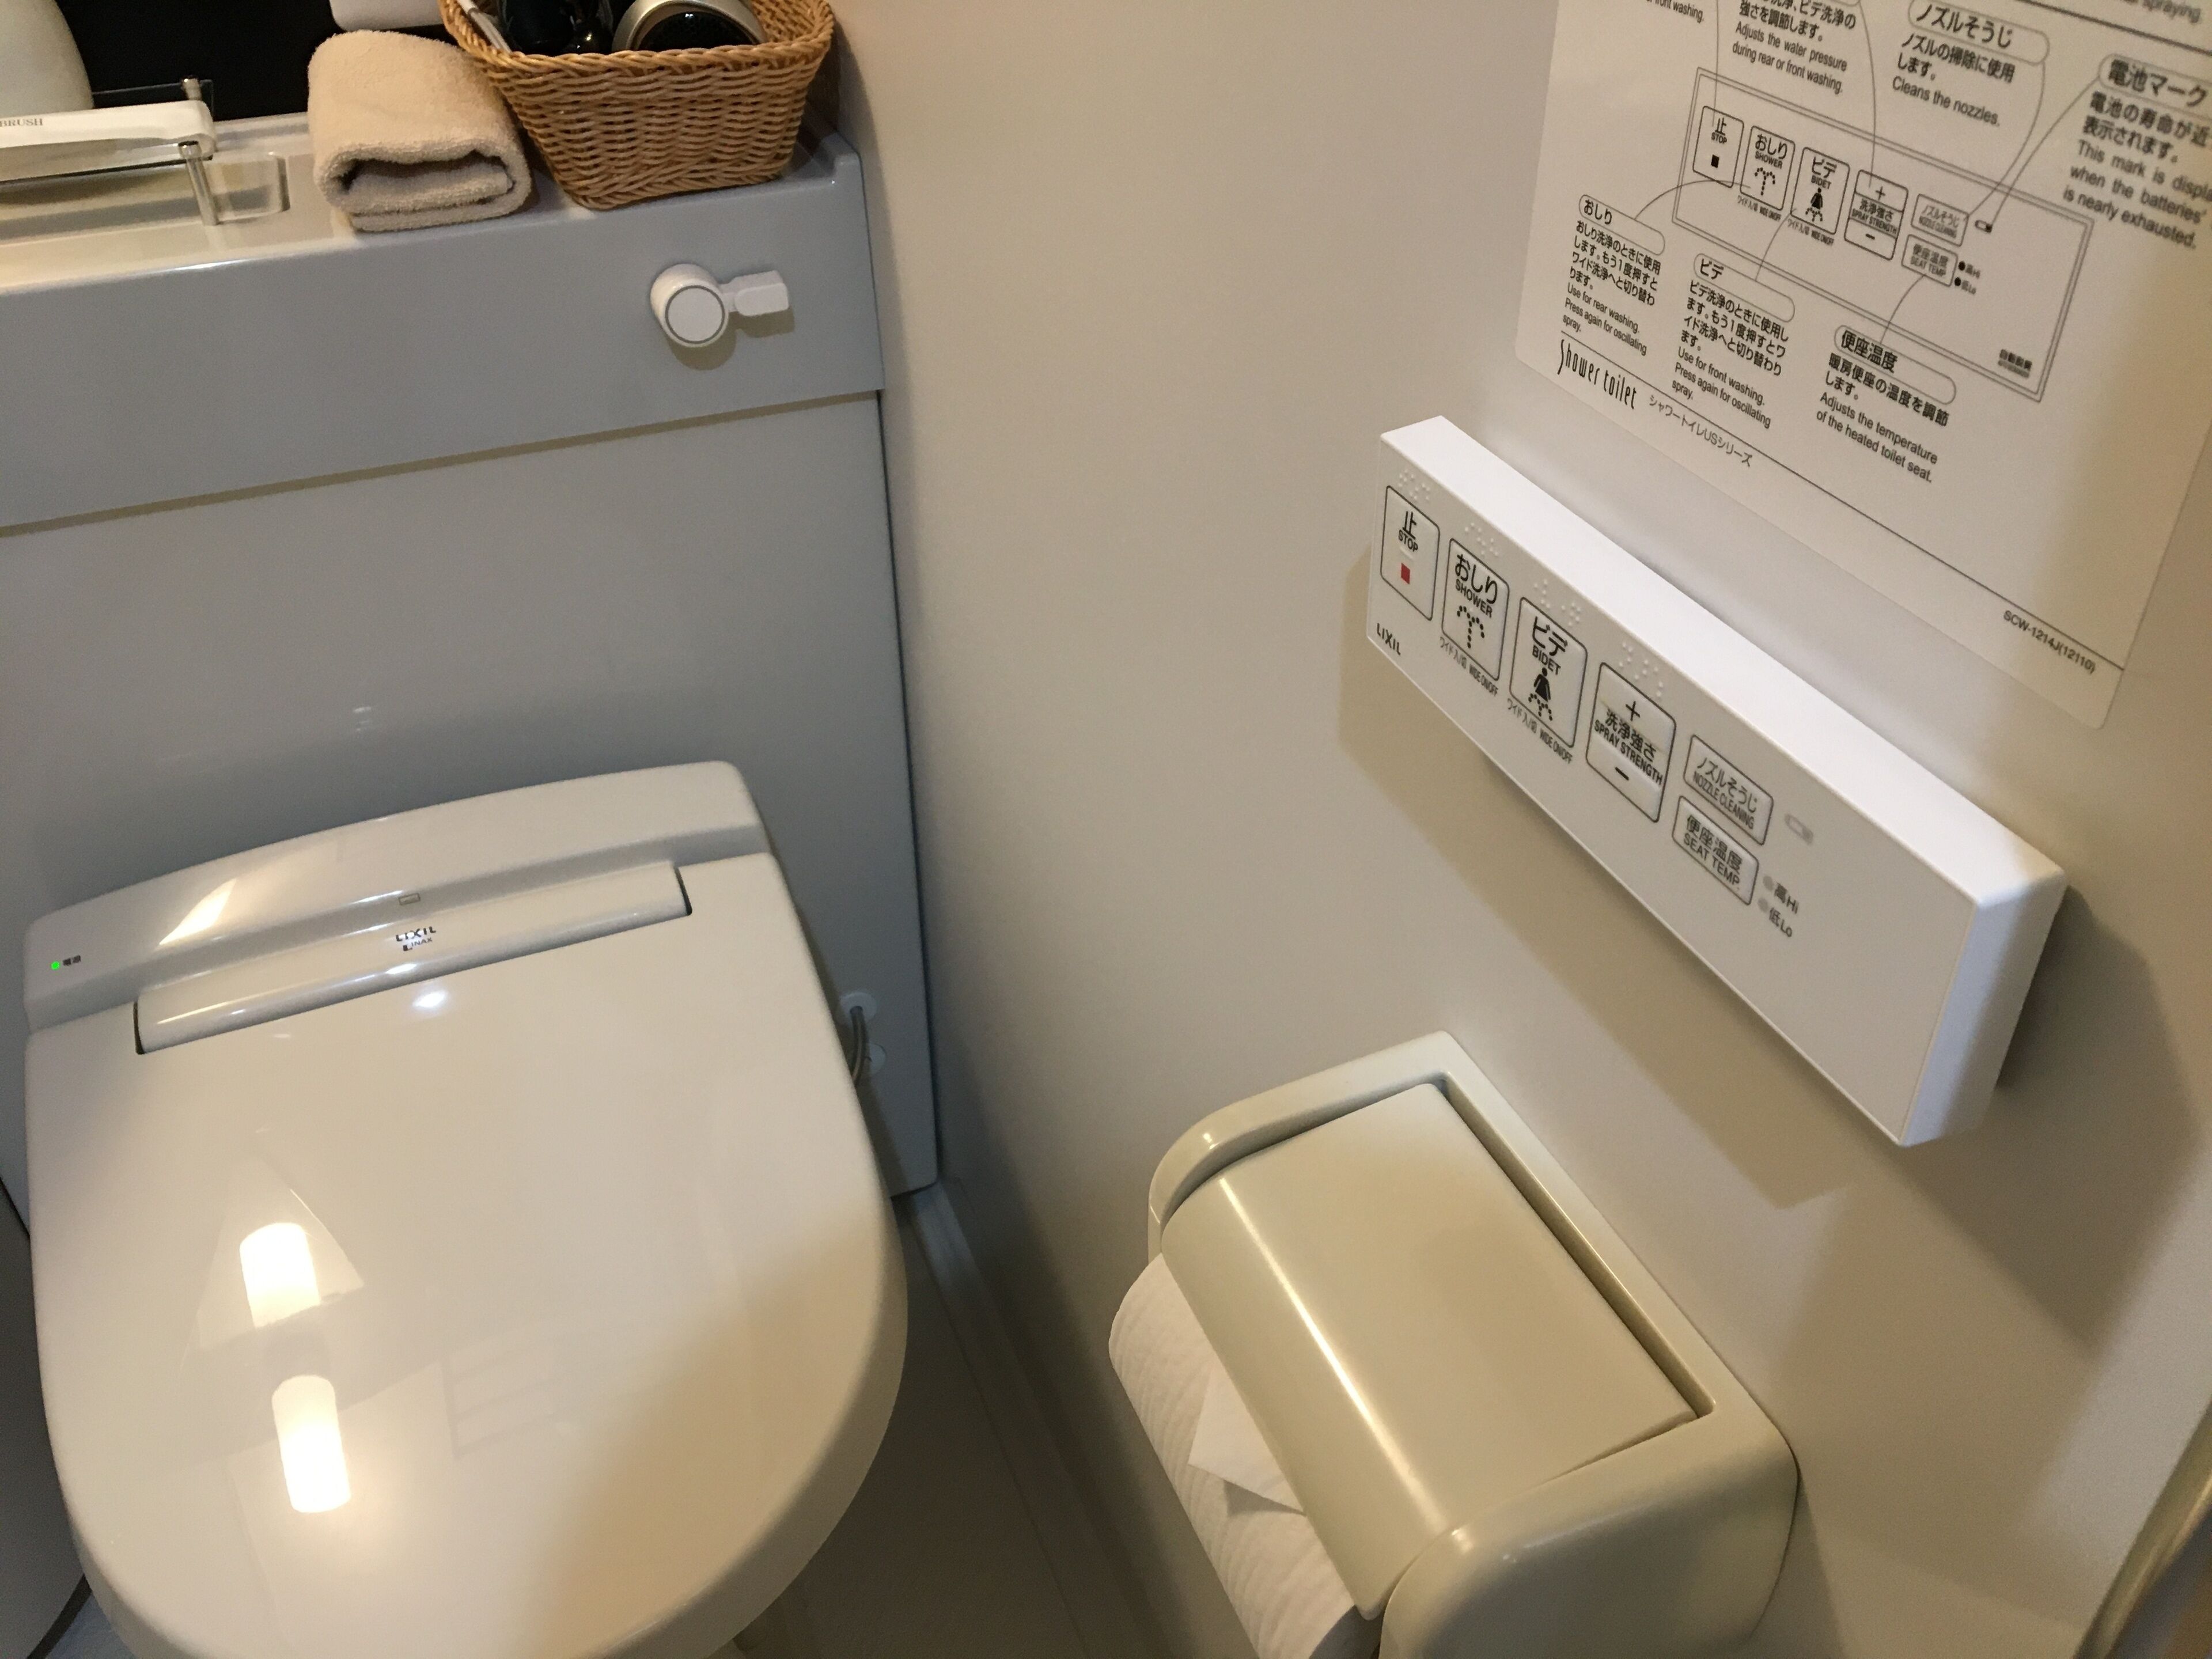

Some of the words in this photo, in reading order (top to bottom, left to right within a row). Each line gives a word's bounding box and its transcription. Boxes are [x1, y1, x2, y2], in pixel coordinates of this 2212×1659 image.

[1673, 2, 1704, 24] washing.
[1740, 2, 1823, 42] 強さを調節します。
[1764, 0, 1856, 29] 浄、ビデ洗浄の
[1916, 4, 2013, 48] ノズルそうじ
[1732, 41, 1756, 63] during
[1758, 52, 1775, 67] rear
[1776, 59, 1785, 69] or
[1786, 60, 1805, 78] front
[1806, 71, 1843, 95] washing.
[1736, 21, 1764, 42] Adjusts
[1768, 32, 1781, 47] the
[1785, 39, 1807, 57] water
[1810, 49, 1847, 72] pressure
[1897, 52, 1936, 81] します。
[1902, 33, 2016, 84] ノズルの掃除に使用
[1892, 76, 1930, 101] Cleans
[1933, 90, 1950, 108] the
[1953, 100, 2000, 126] nozzles.
[2108, 59, 2207, 107] 電池マーク
[1711, 132, 1727, 144] STOP
[1715, 117, 1727, 136] 止
[1755, 133, 1787, 160] おしり
[1755, 151, 1783, 169] SHOWER
[1812, 157, 1837, 178] ビデ
[2070, 165, 2105, 188] when
[2112, 178, 2134, 198] the
[2079, 139, 2105, 163] This
[2111, 156, 2146, 177] mark
[2153, 167, 2165, 184] is
[1811, 175, 1832, 190] BIDET
[1584, 199, 1612, 225] おしり
[1851, 209, 1868, 222] SPRAY
[1869, 215, 1897, 234] STRENGTH
[2063, 184, 2074, 202] is
[2077, 194, 2119, 221] nearly
[2121, 210, 2196, 249] exhausted.
[1576, 220, 1661, 275] おしり洗浄のときに使用
[1700, 259, 1724, 279] ビデ
[1570, 266, 1593, 290] ります。
[1573, 251, 1655, 305] ワイド洗浄へと切り替わ
[1562, 315, 1581, 333] spray.
[1565, 297, 1583, 317] Press
[1584, 310, 1602, 328] again
[1604, 320, 1613, 334] for
[1613, 328, 1647, 356] oscillating
[1567, 282, 1581, 298] Use
[1582, 291, 1592, 305] for
[1593, 300, 1608, 313] rear
[1609, 308, 1639, 334] washing.
[1690, 280, 1789, 342] ビデ洗浄のときに使用し
[1681, 329, 1701, 351] ます。
[1684, 316, 1782, 376] イド洗浄へと切り替わり
[1840, 329, 1898, 373] 便座温度
[1557, 339, 1600, 385] Shower
[1604, 370, 1637, 410] toilet
[1672, 380, 1693, 400] spray.
[1675, 362, 1696, 382] Press
[1697, 377, 1718, 396] again
[1719, 388, 1730, 403] for
[1732, 397, 1771, 429] oscillating
[1678, 346, 1694, 363] Use
[1695, 356, 1707, 370] for
[1708, 363, 1727, 383] front
[1729, 377, 1764, 406] washing.
[1825, 370, 1858, 400] します。
[1828, 353, 1950, 427] 暖房便座の温度を調節
[1649, 395, 1752, 467] シャワートイレUSシリーズ
[1816, 410, 1827, 423] of
[1828, 415, 1843, 432] the
[1845, 424, 1879, 452] heated
[1881, 444, 1906, 467] toilet
[1907, 461, 1931, 483] seat.
[1820, 392, 1855, 419] Adjusts
[1858, 412, 1873, 429] the
[1876, 422, 1937, 464] temperature
[1398, 529, 1418, 552] STOP
[1402, 510, 1416, 540] 止
[1455, 554, 1498, 604] おしり
[1455, 578, 1493, 618] SHOWER
[1376, 622, 1401, 656] LIXIL
[1532, 616, 1568, 656] ビデ
[2003, 609, 2096, 675] SCW-1214J(12110)
[1532, 644, 1562, 676] BIDET
[1594, 719, 1619, 747] SPRAY
[1620, 741, 1662, 785] STRENGTH
[1605, 708, 1656, 762] 洗浄強さ
[1693, 771, 1719, 801] NOZZLE
[1719, 793, 1755, 830] CLEANING
[1697, 757, 1758, 813] ノズルそうじ
[1683, 832, 1710, 861] SEAT
[1687, 814, 1743, 874] 便座温度
[396, 926, 436, 941] LIXIL
[411, 937, 433, 946] INAX
